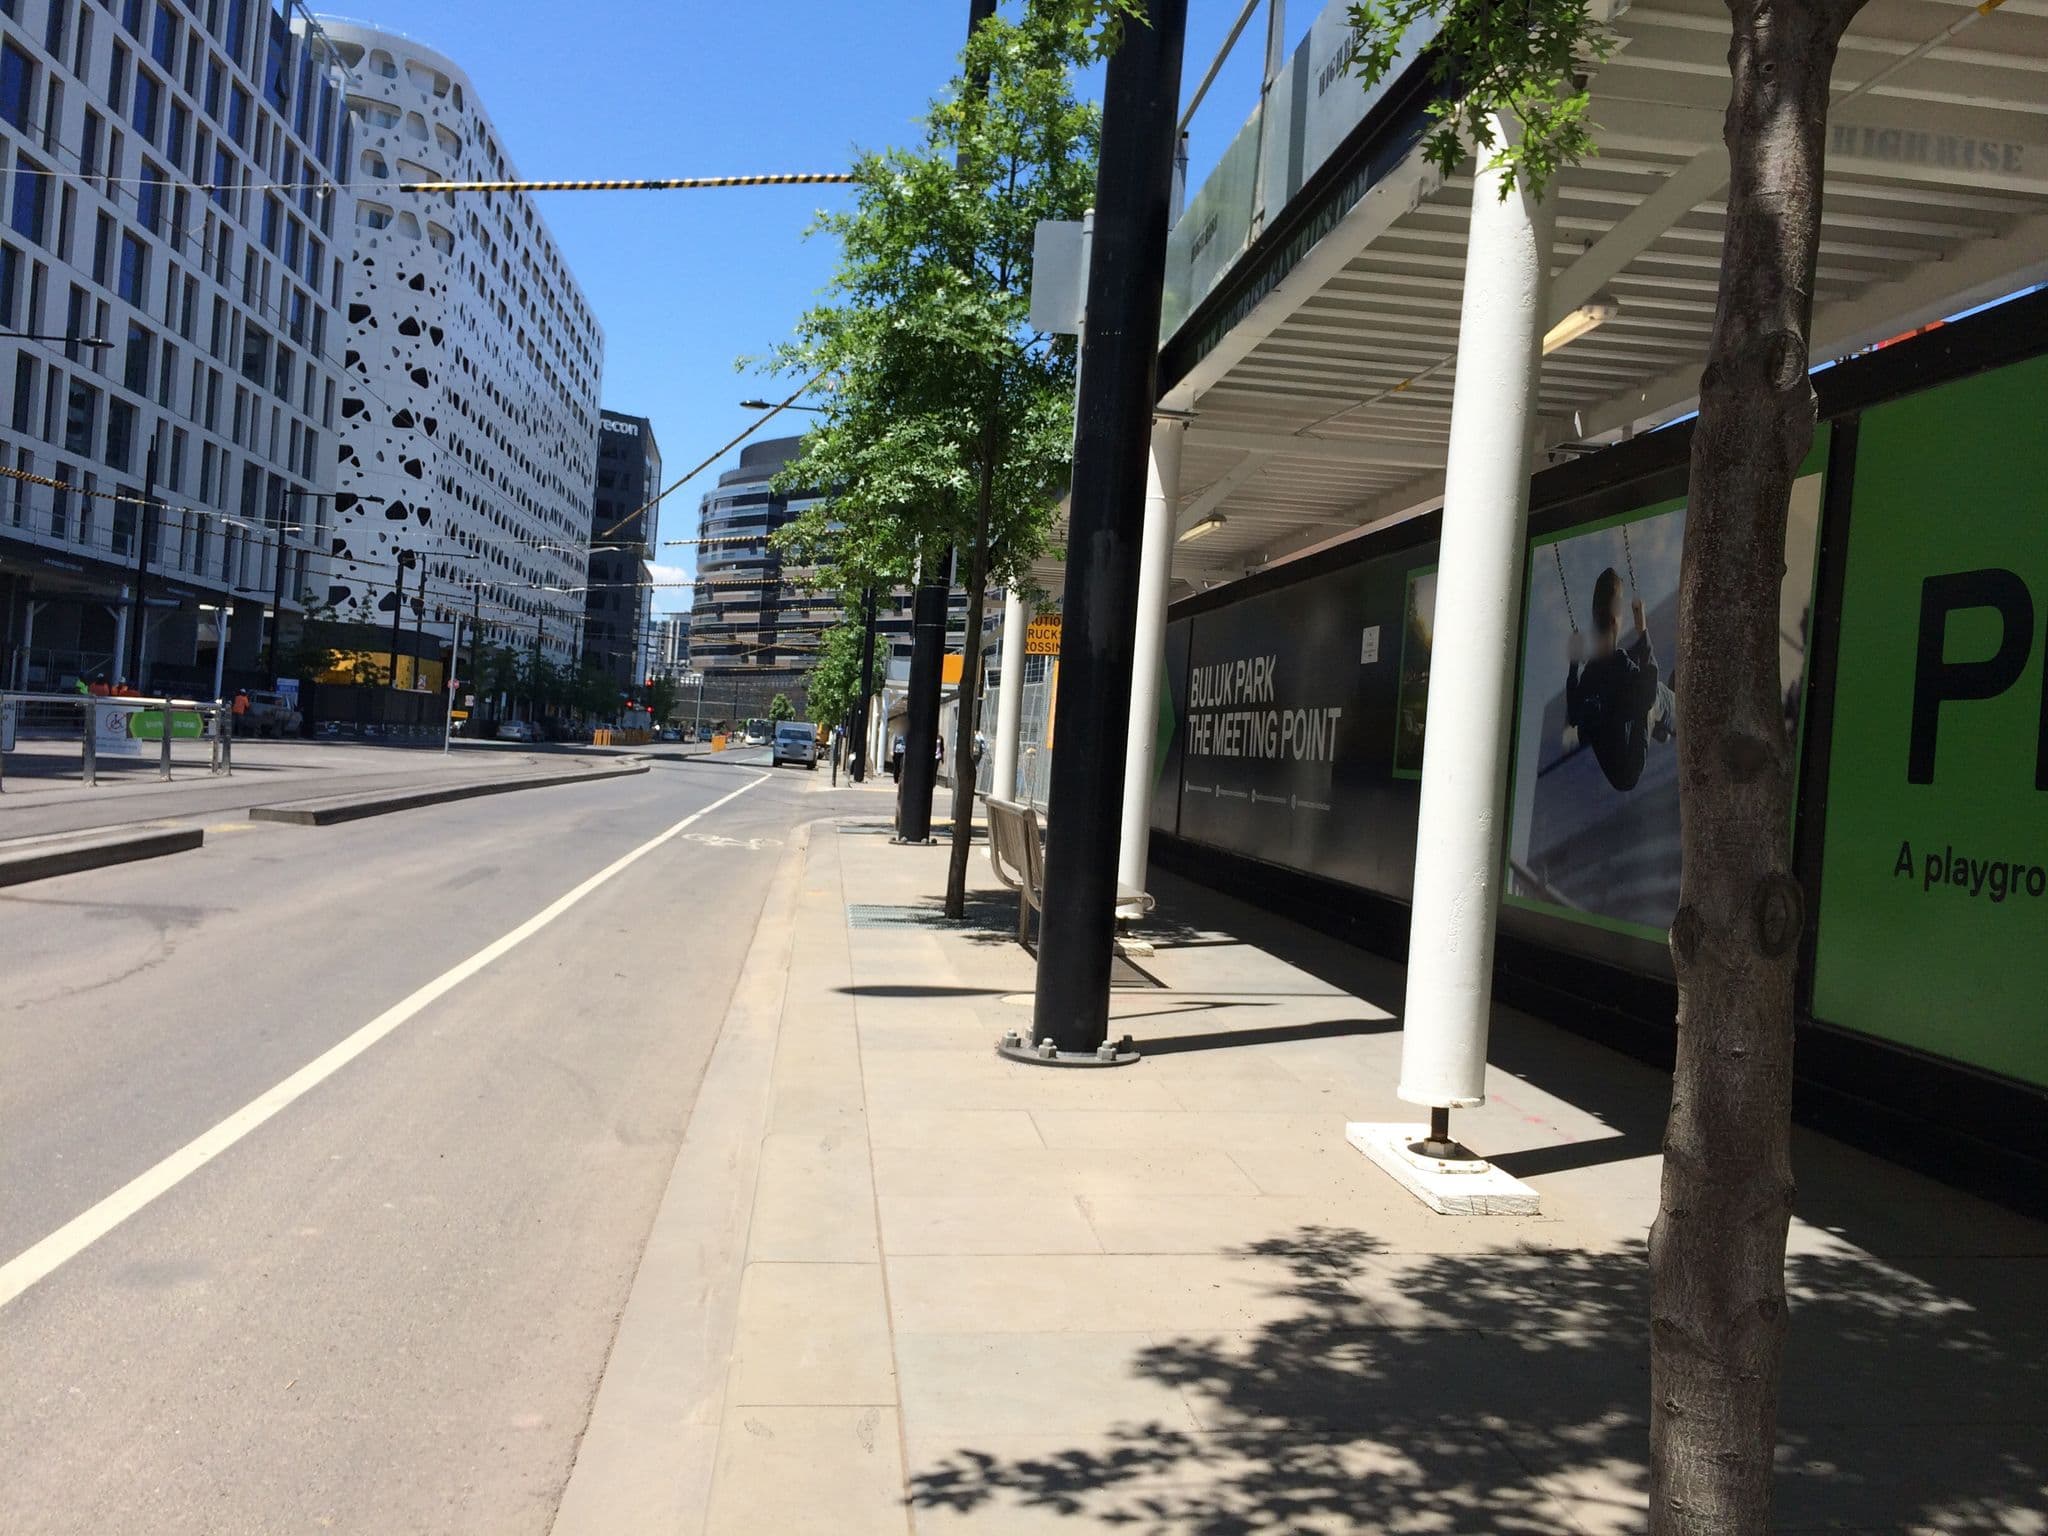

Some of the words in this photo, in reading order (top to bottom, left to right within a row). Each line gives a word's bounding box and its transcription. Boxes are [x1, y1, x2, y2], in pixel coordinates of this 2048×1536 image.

[1831, 126, 2024, 173] HIGHRISE
[1190, 661, 1234, 708] BULUK
[1234, 654, 1276, 705] PARK
[1189, 713, 1212, 755] THE
[1212, 709, 1278, 759] MEETING
[1280, 706, 1342, 762] POINT
[1893, 839, 1915, 879] A
[1923, 844, 2047, 904] playgro
